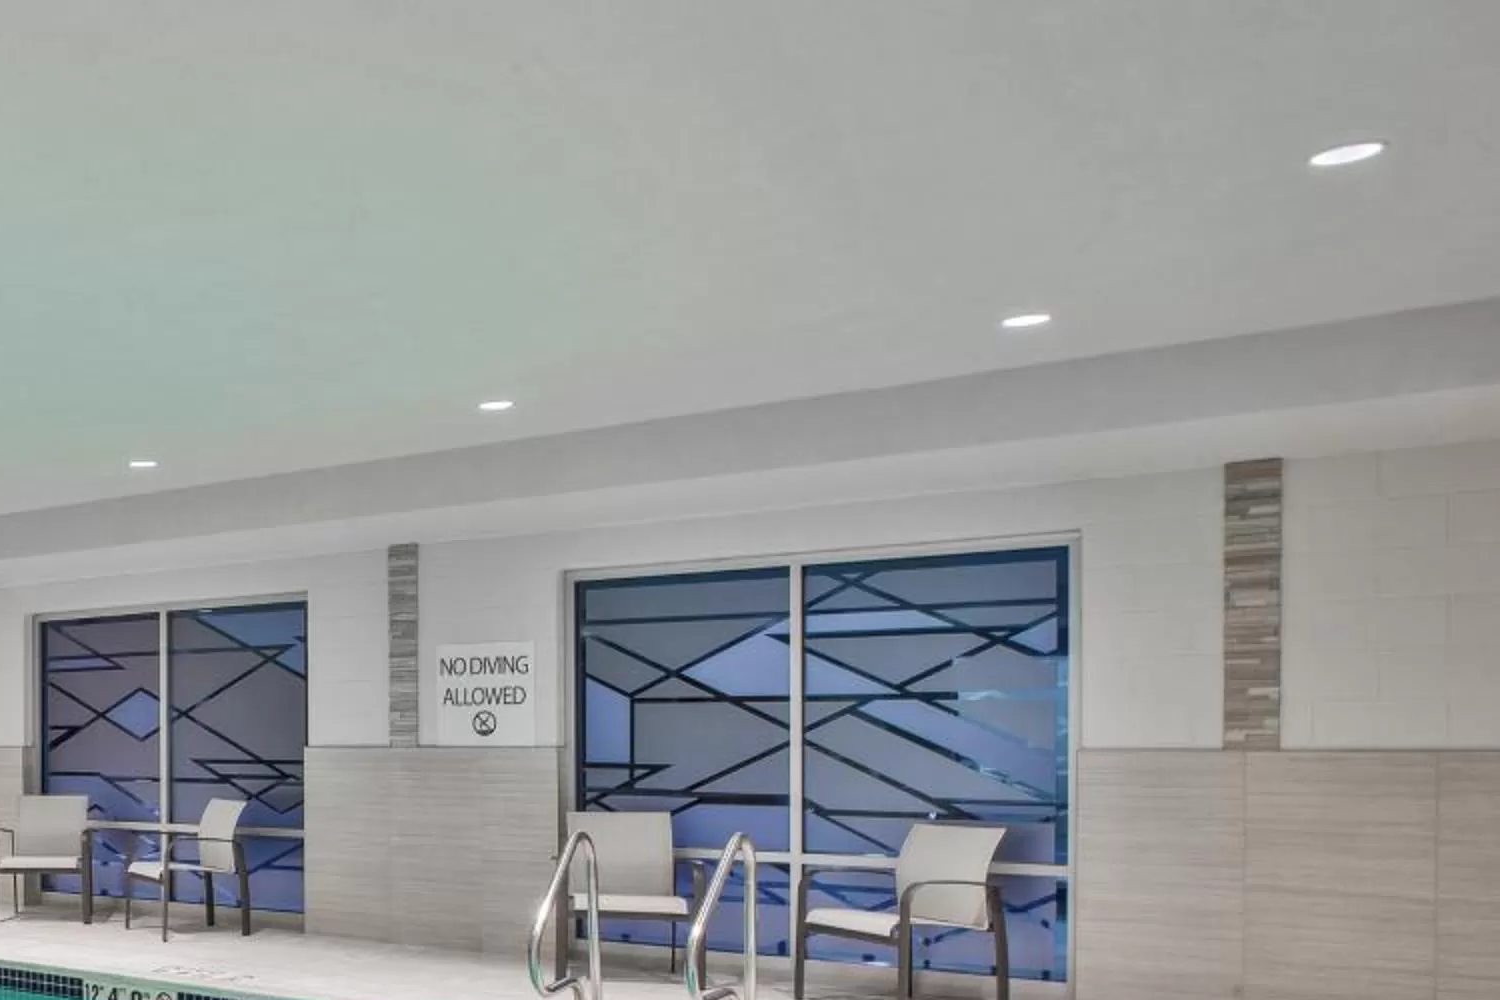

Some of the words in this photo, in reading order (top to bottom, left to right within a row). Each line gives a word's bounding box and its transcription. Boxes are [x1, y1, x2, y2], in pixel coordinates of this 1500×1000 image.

[440, 657, 467, 676] NO
[470, 655, 529, 675] DIVING
[443, 686, 527, 706] ALLOWED
